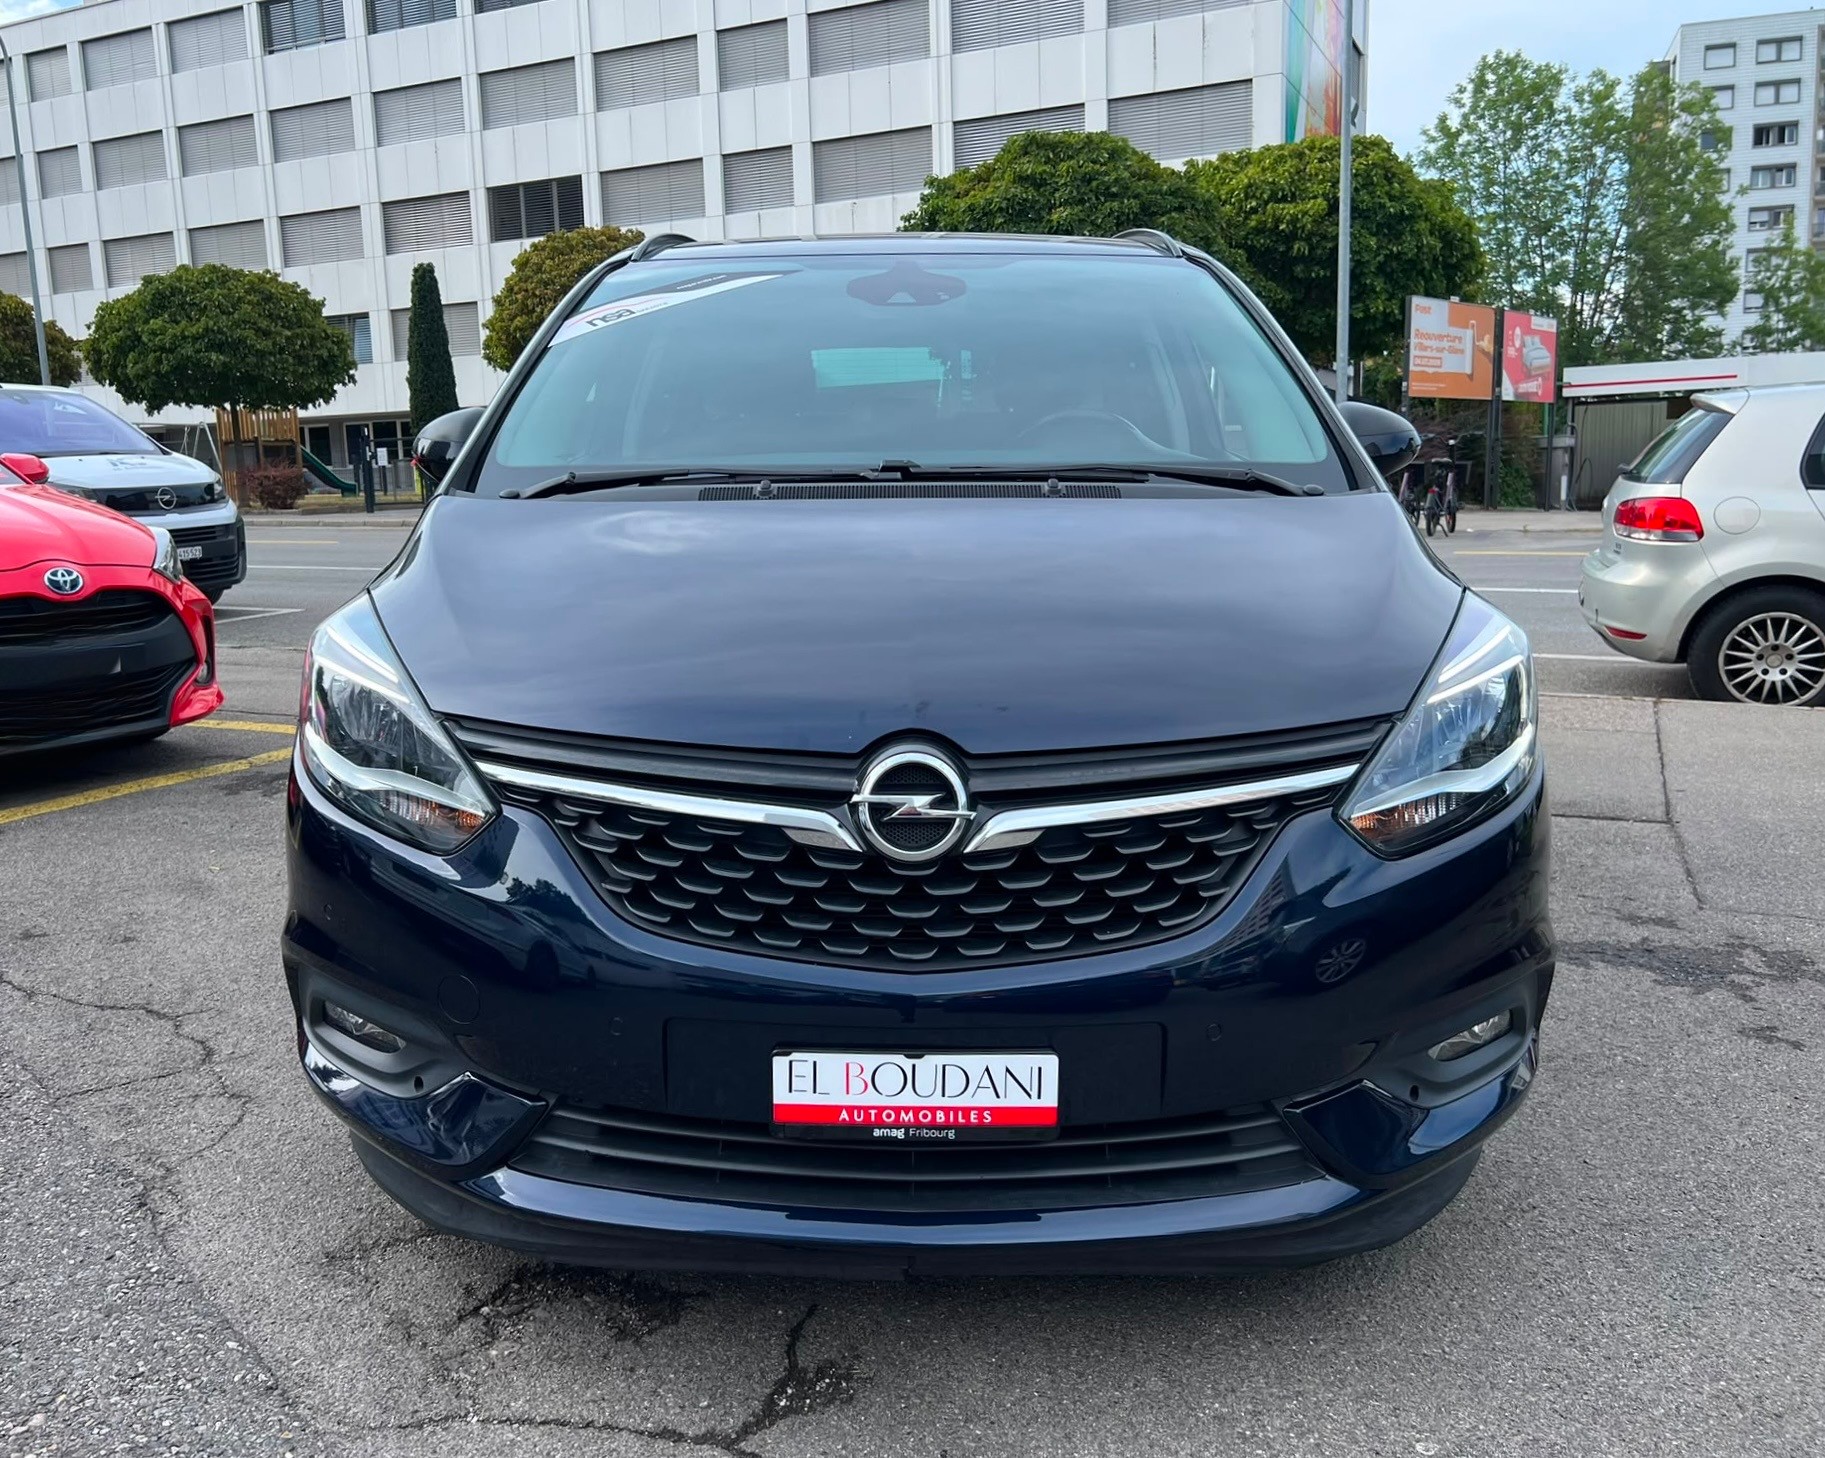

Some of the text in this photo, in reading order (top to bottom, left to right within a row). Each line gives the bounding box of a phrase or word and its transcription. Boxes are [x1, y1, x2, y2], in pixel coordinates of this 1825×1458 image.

[585, 309, 636, 327] nsa
[788, 1059, 1042, 1100] EL BOUDANI
[838, 1108, 992, 1123] AUTOMOBILES
[873, 1127, 956, 1139] amag Fribourg
